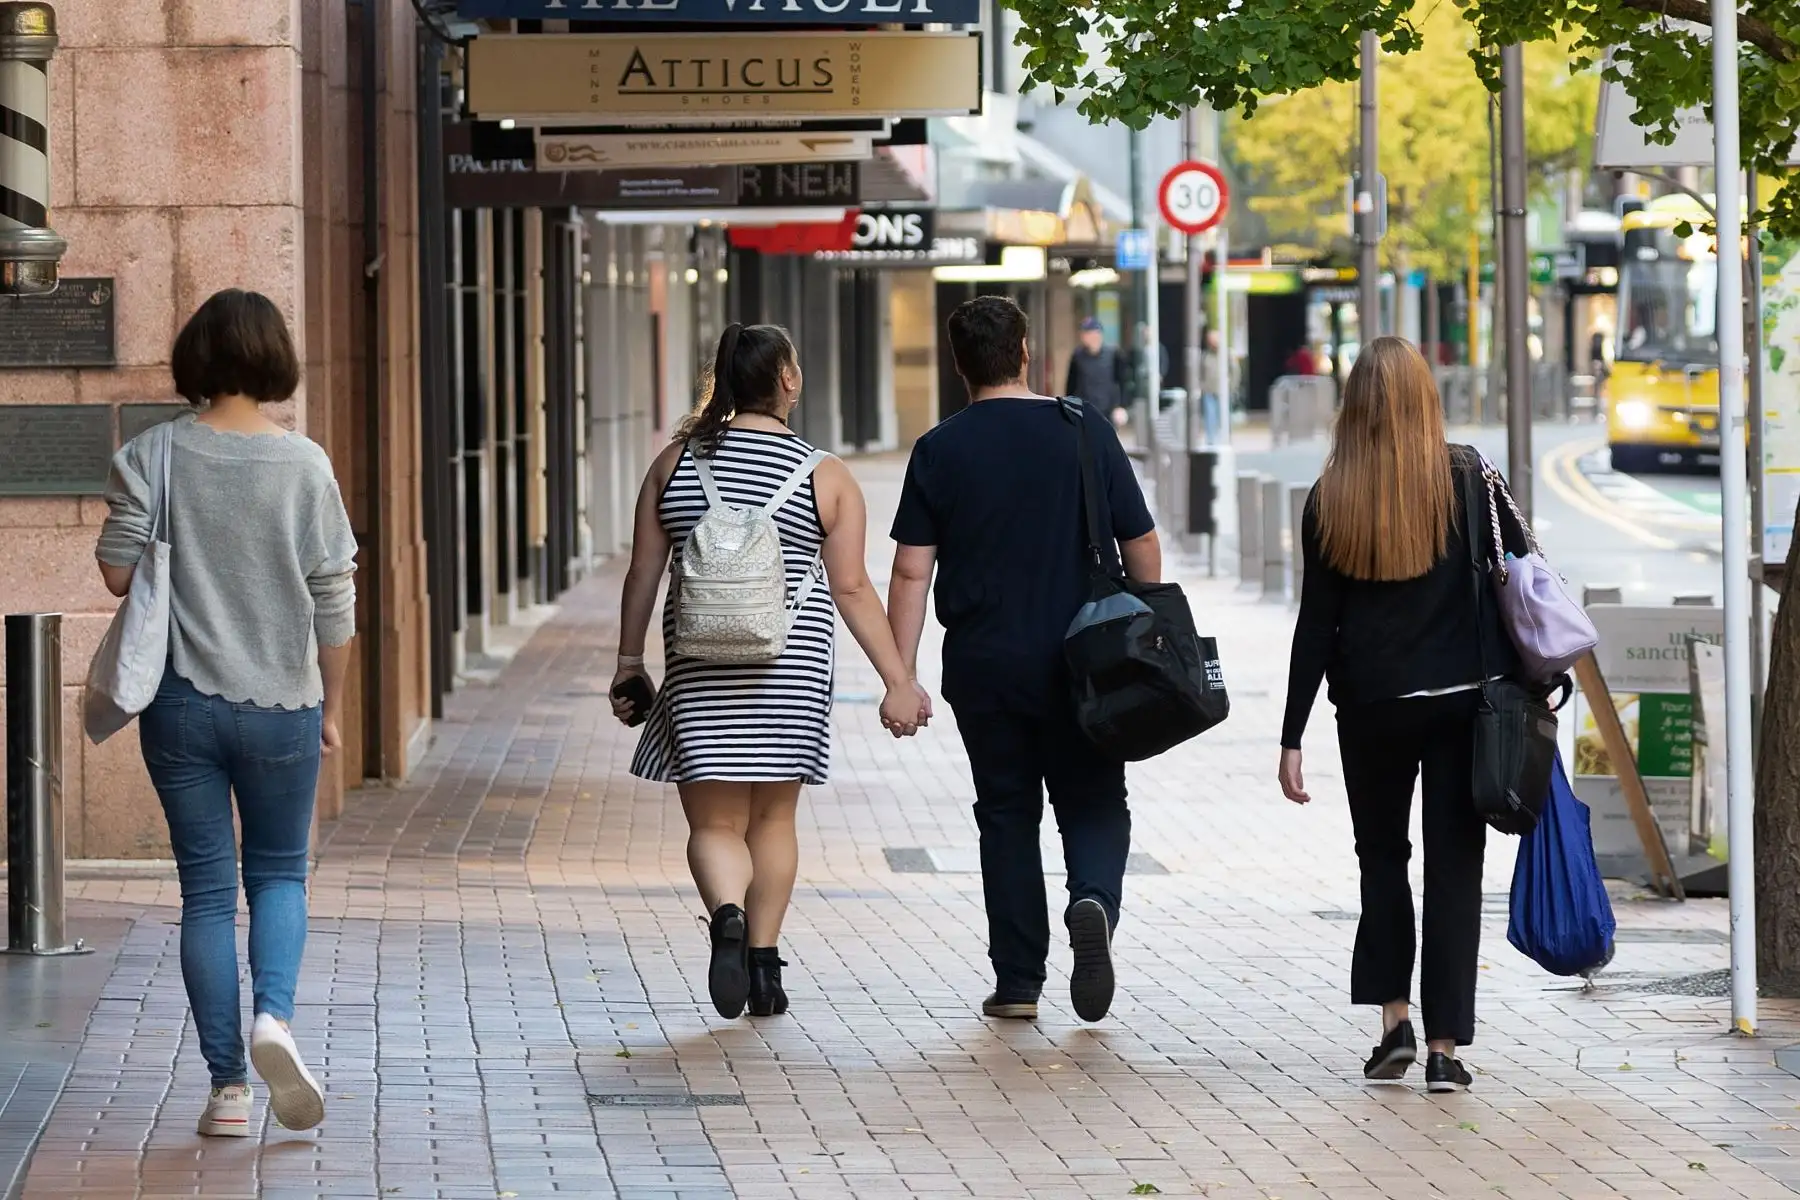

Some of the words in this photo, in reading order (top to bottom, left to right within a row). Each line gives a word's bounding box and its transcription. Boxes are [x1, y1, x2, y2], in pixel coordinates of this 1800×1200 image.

[588, 49, 600, 104] MENS
[618, 45, 833, 88] ATTICUS
[849, 42, 861, 106] WOMENS
[681, 95, 771, 105] SHOES
[776, 163, 852, 198] NEW
[1176, 184, 1214, 210] 30
